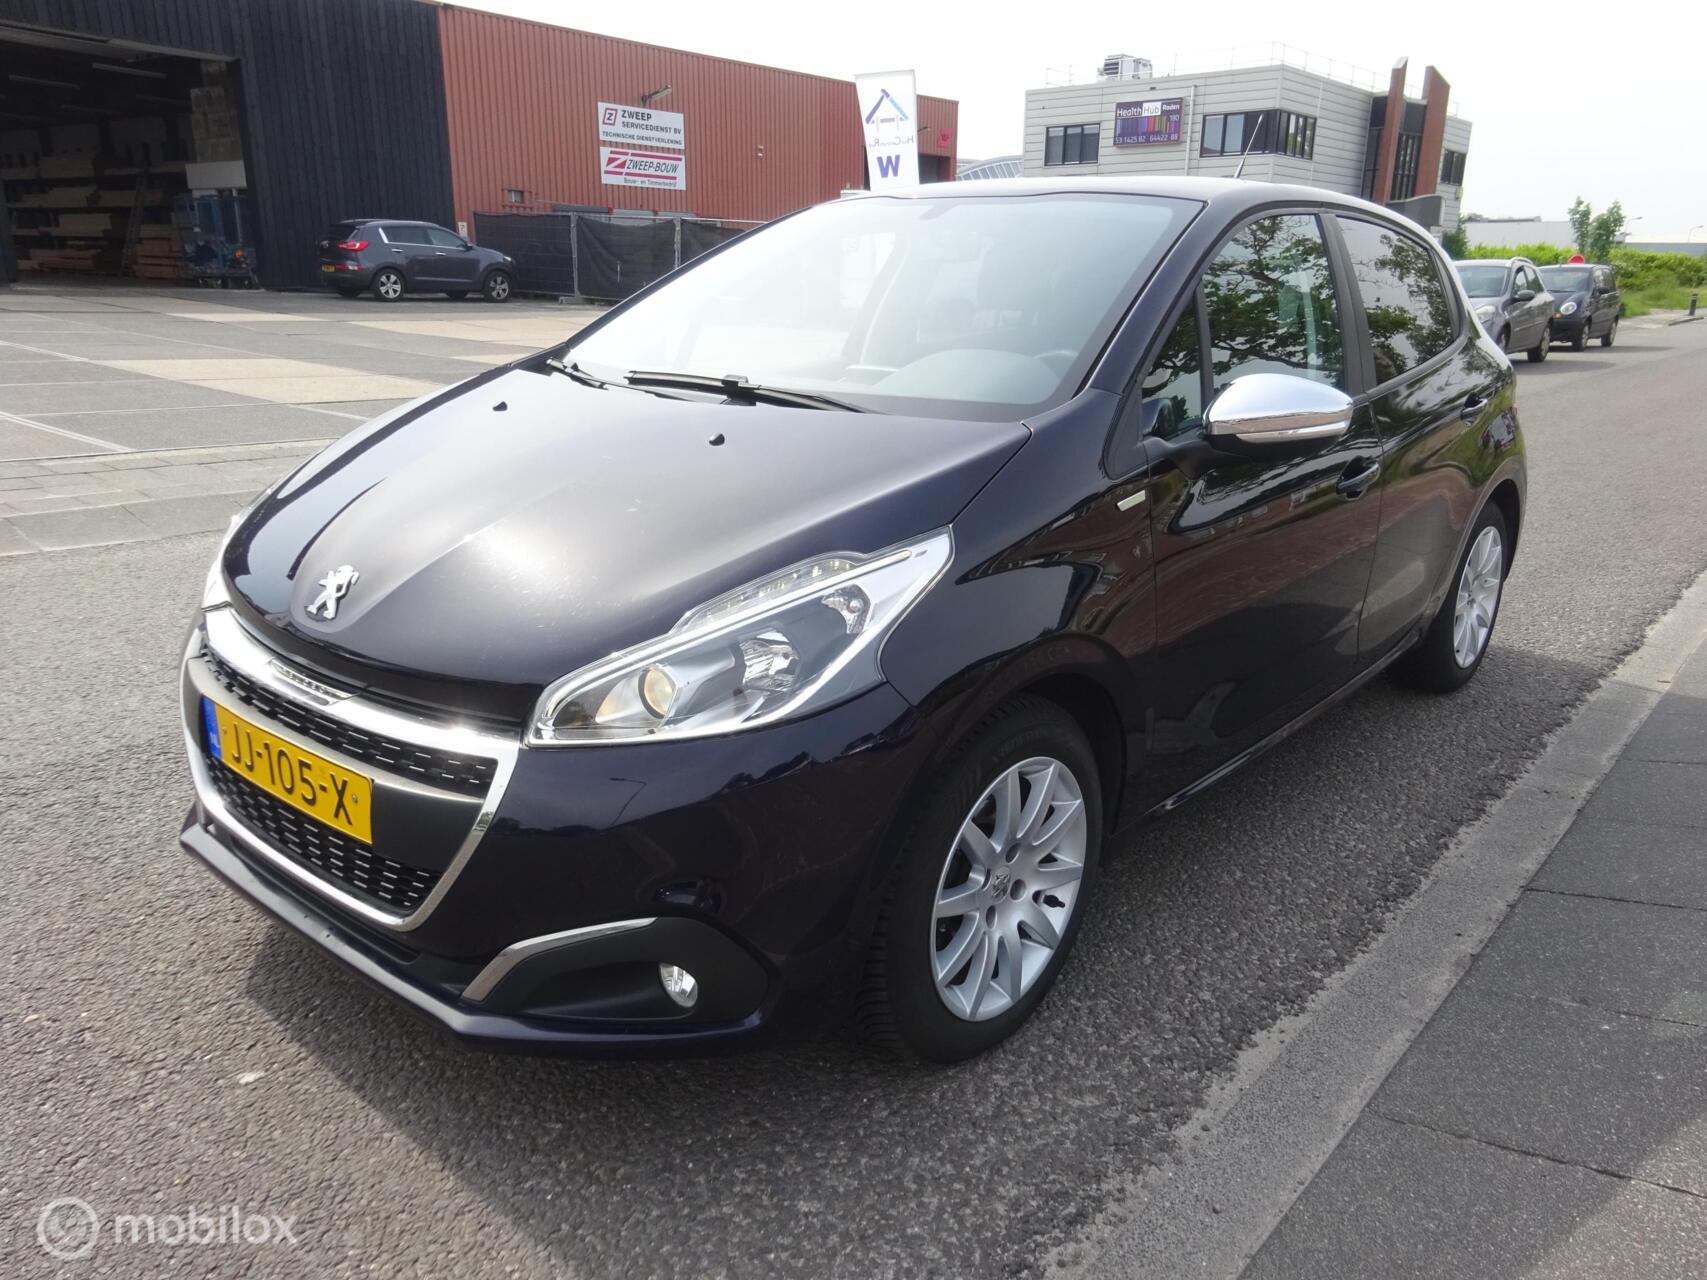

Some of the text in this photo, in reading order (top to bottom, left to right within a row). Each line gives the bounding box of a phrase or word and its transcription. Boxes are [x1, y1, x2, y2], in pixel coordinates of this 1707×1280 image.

[621, 110, 652, 121] ZWEEP
[1117, 107, 1142, 117] Health
[1144, 105, 1160, 114] Hub
[622, 121, 672, 133] SERVICEDIENST
[602, 131, 682, 145] TECHNISCHE DIENSTVERLENING
[627, 159, 679, 173] ZWEEP-BOUW
[876, 154, 900, 178] W
[232, 722, 353, 827] JJ-105-X
